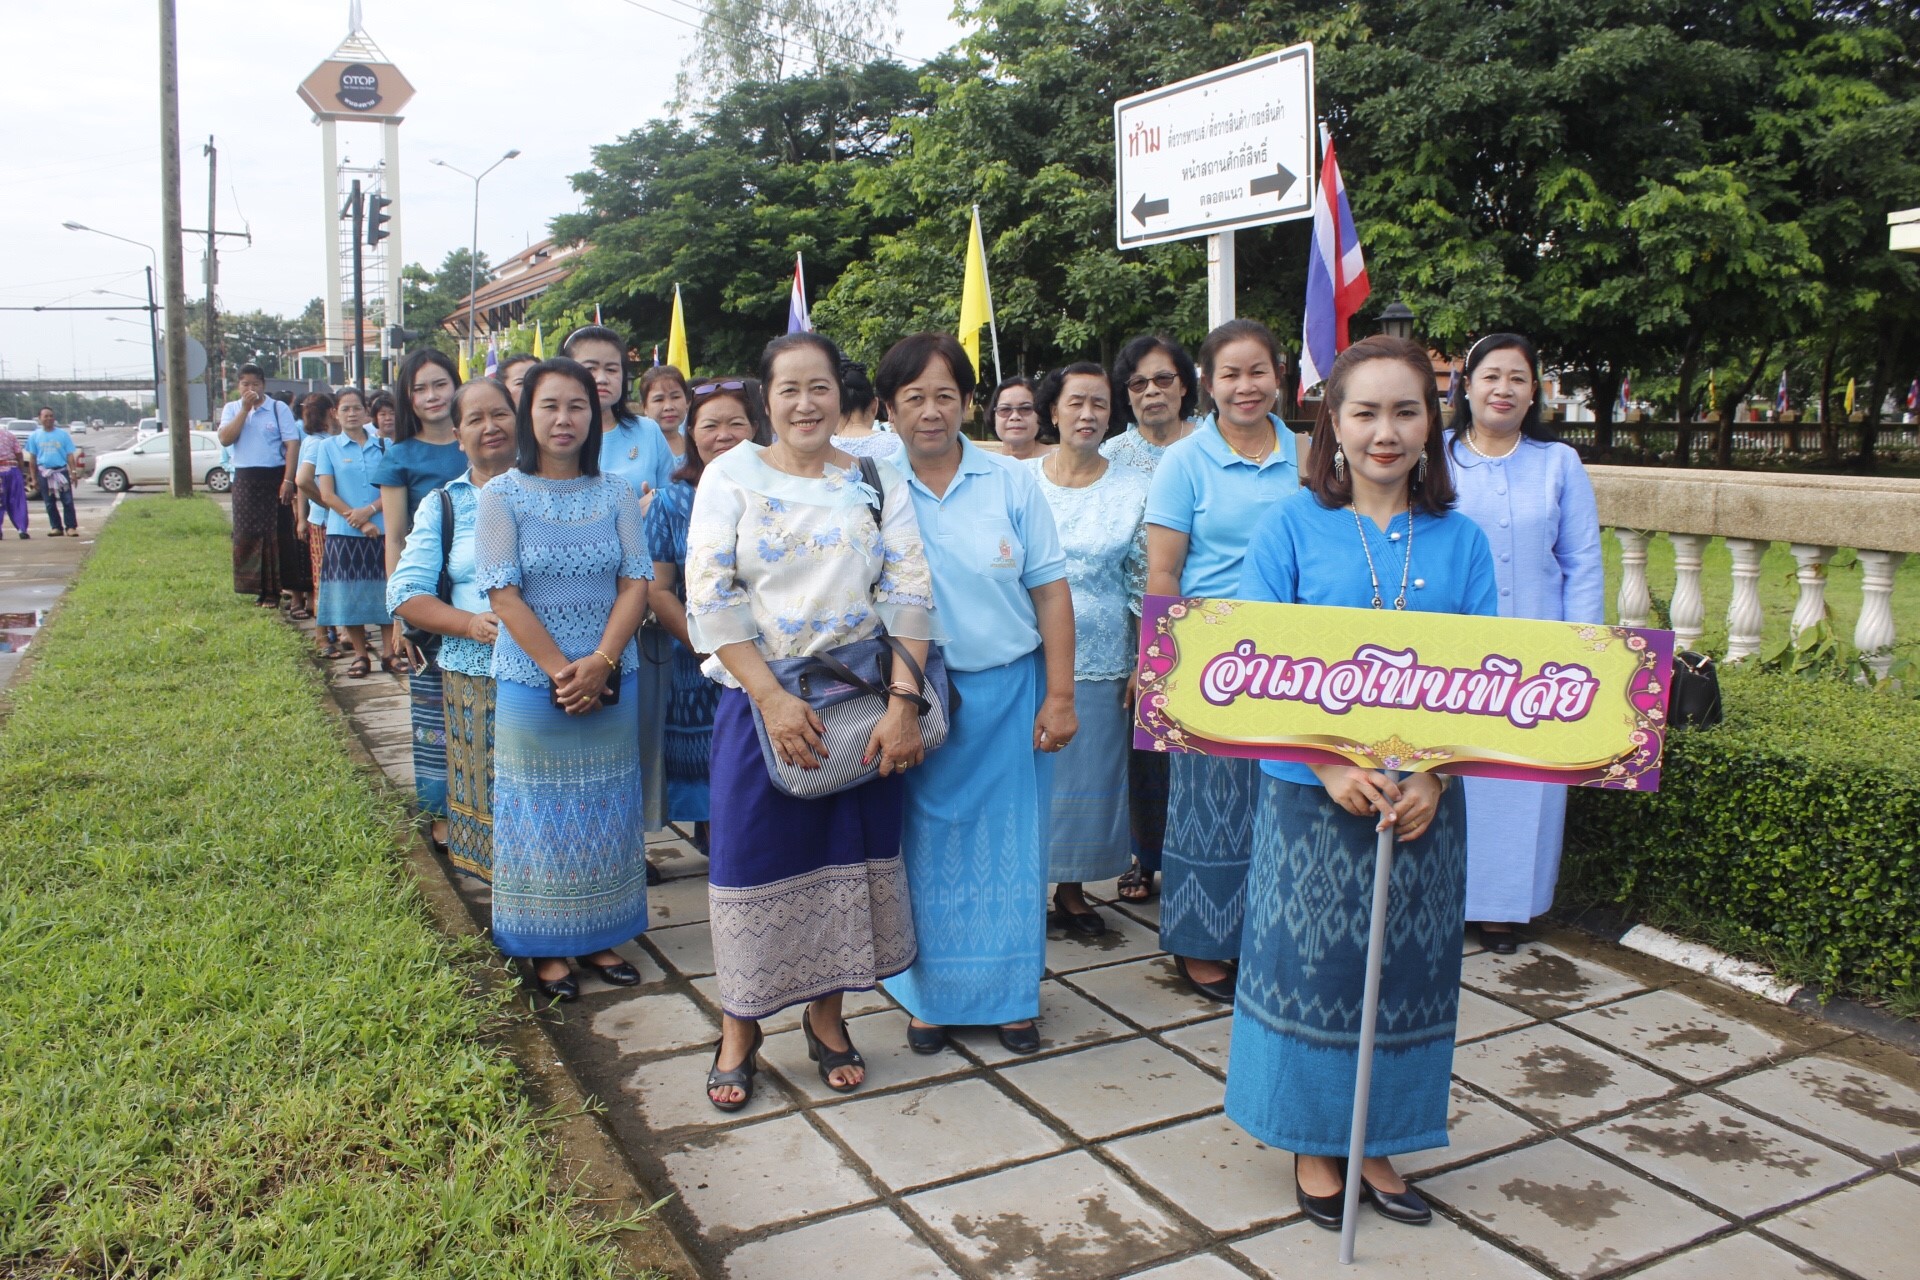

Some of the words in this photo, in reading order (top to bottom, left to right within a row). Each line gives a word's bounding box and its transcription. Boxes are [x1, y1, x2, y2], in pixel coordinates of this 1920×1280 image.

[343, 75, 375, 85] OTOP
[1129, 120, 1160, 158] ห้าม
[1181, 136, 1268, 181] หน้าสถานศักดิ์สิทธิ์
[1199, 186, 1244, 206] ตลอดแนว
[1201, 640, 1599, 727] อำเภอโพนพิสัย
